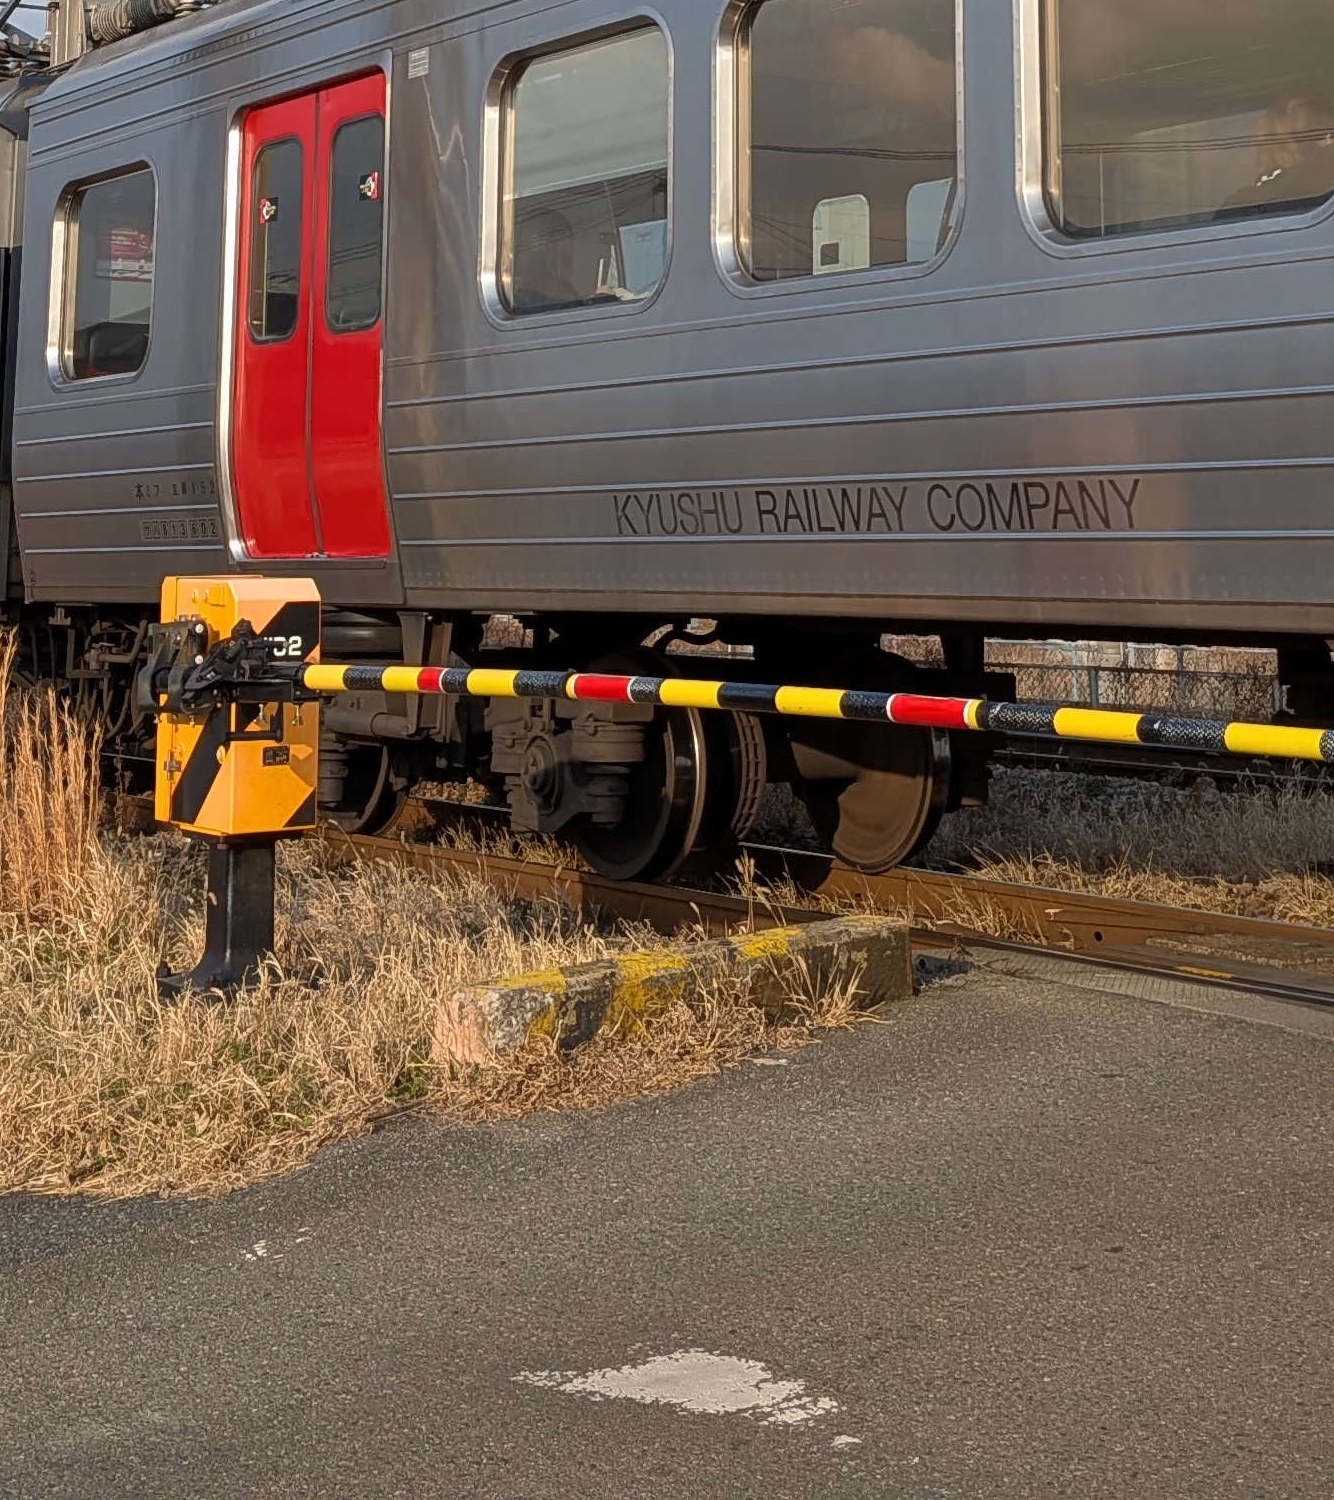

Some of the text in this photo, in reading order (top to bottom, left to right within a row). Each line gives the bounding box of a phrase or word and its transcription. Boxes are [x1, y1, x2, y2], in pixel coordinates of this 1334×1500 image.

[613, 478, 1141, 536] KYUSHU RAILWAY COMPANY
